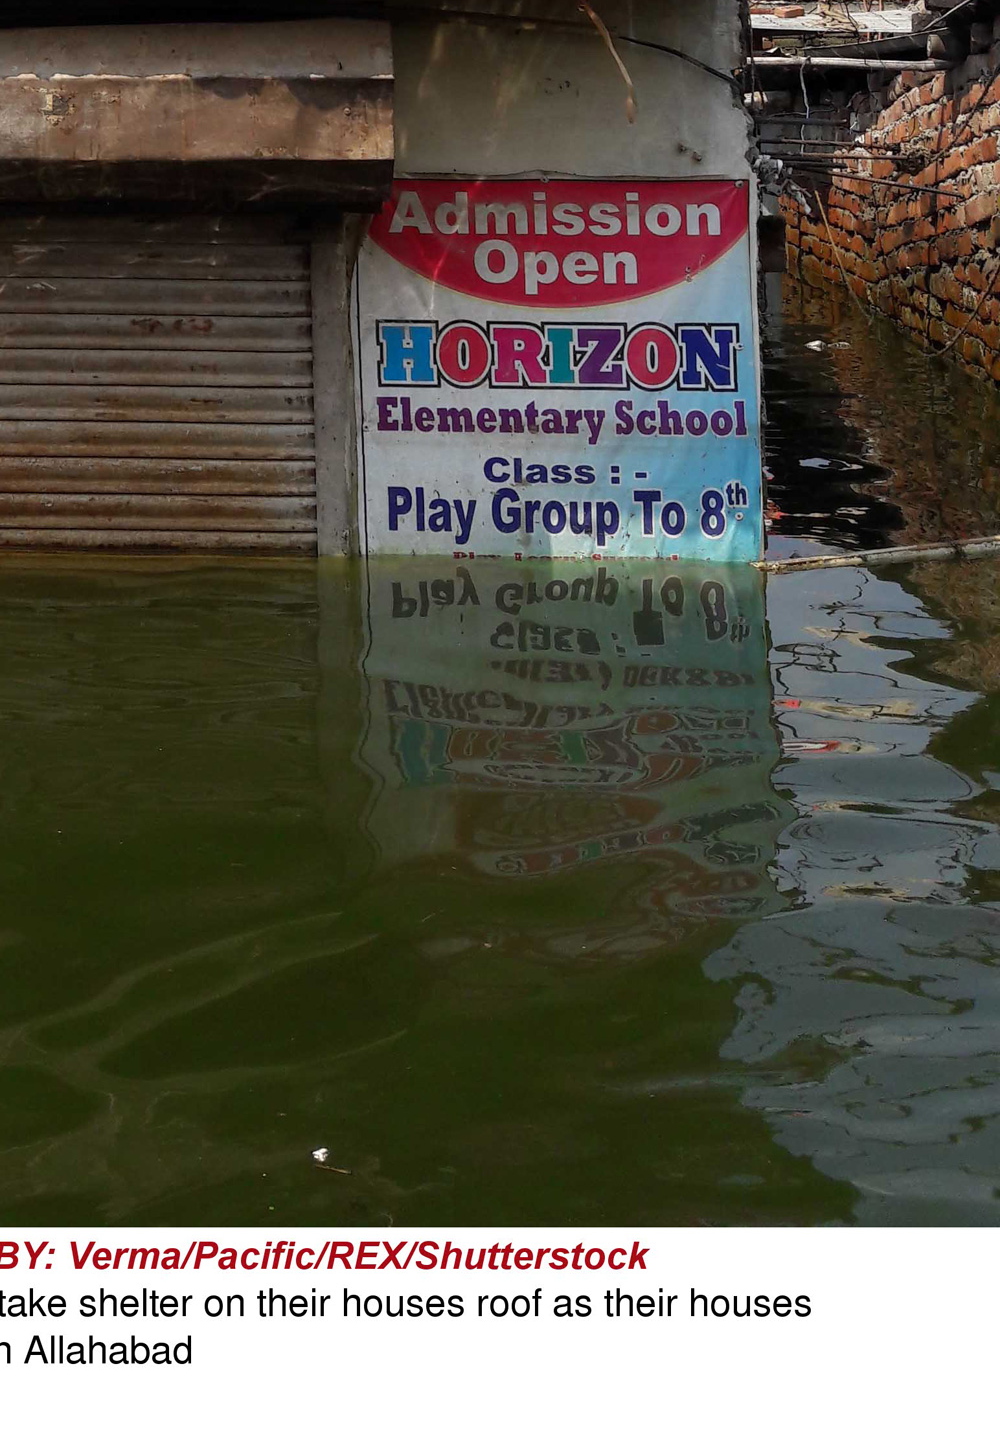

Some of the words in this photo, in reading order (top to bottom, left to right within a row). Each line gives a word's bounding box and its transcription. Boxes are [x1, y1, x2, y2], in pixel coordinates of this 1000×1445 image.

[388, 191, 721, 237] Admission
[473, 239, 638, 295] Open
[376, 320, 739, 392] HORIZON
[377, 397, 606, 444] Elementary
[614, 400, 748, 437] School
[483, 457, 597, 485] Class
[387, 486, 477, 544] Play
[491, 488, 620, 546] Group
[633, 490, 687, 537] To
